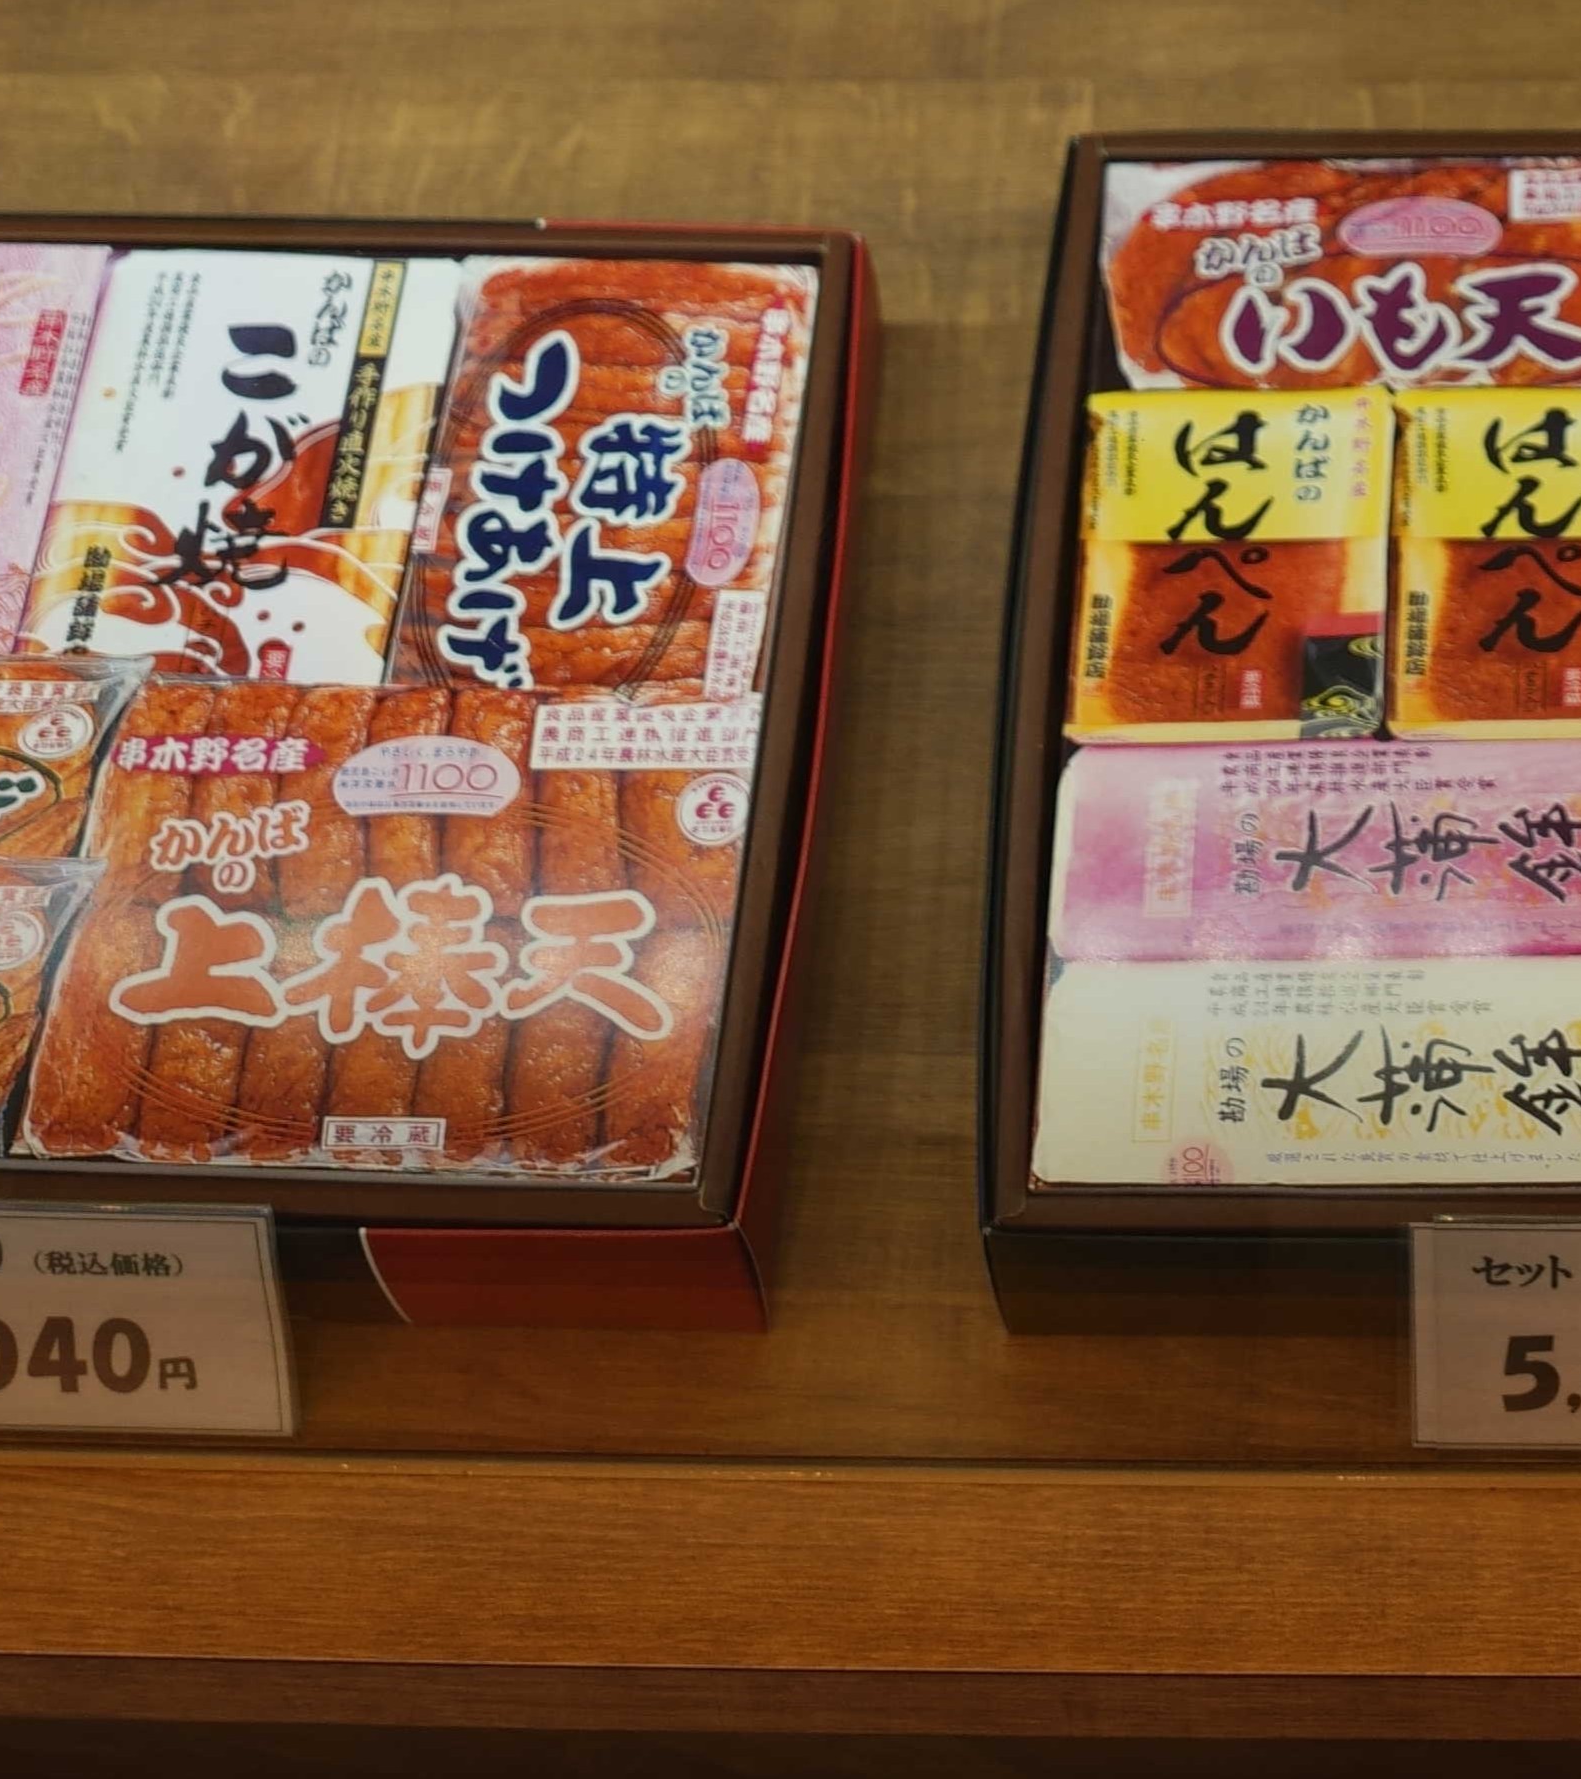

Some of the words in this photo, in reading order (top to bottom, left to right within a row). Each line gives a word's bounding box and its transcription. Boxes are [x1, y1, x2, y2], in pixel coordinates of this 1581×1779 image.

[1294, 402, 1331, 503] かんばの
[448, 337, 578, 692] つけあげ
[560, 422, 685, 627] 特上
[1159, 409, 1273, 656] はんぺん
[118, 737, 308, 774] 串木野名産
[150, 802, 310, 893] かんばの
[116, 879, 670, 1055] 上棒天
[32, 1249, 184, 1277] (税込価格)
[1472, 1254, 1573, 1289] セット
